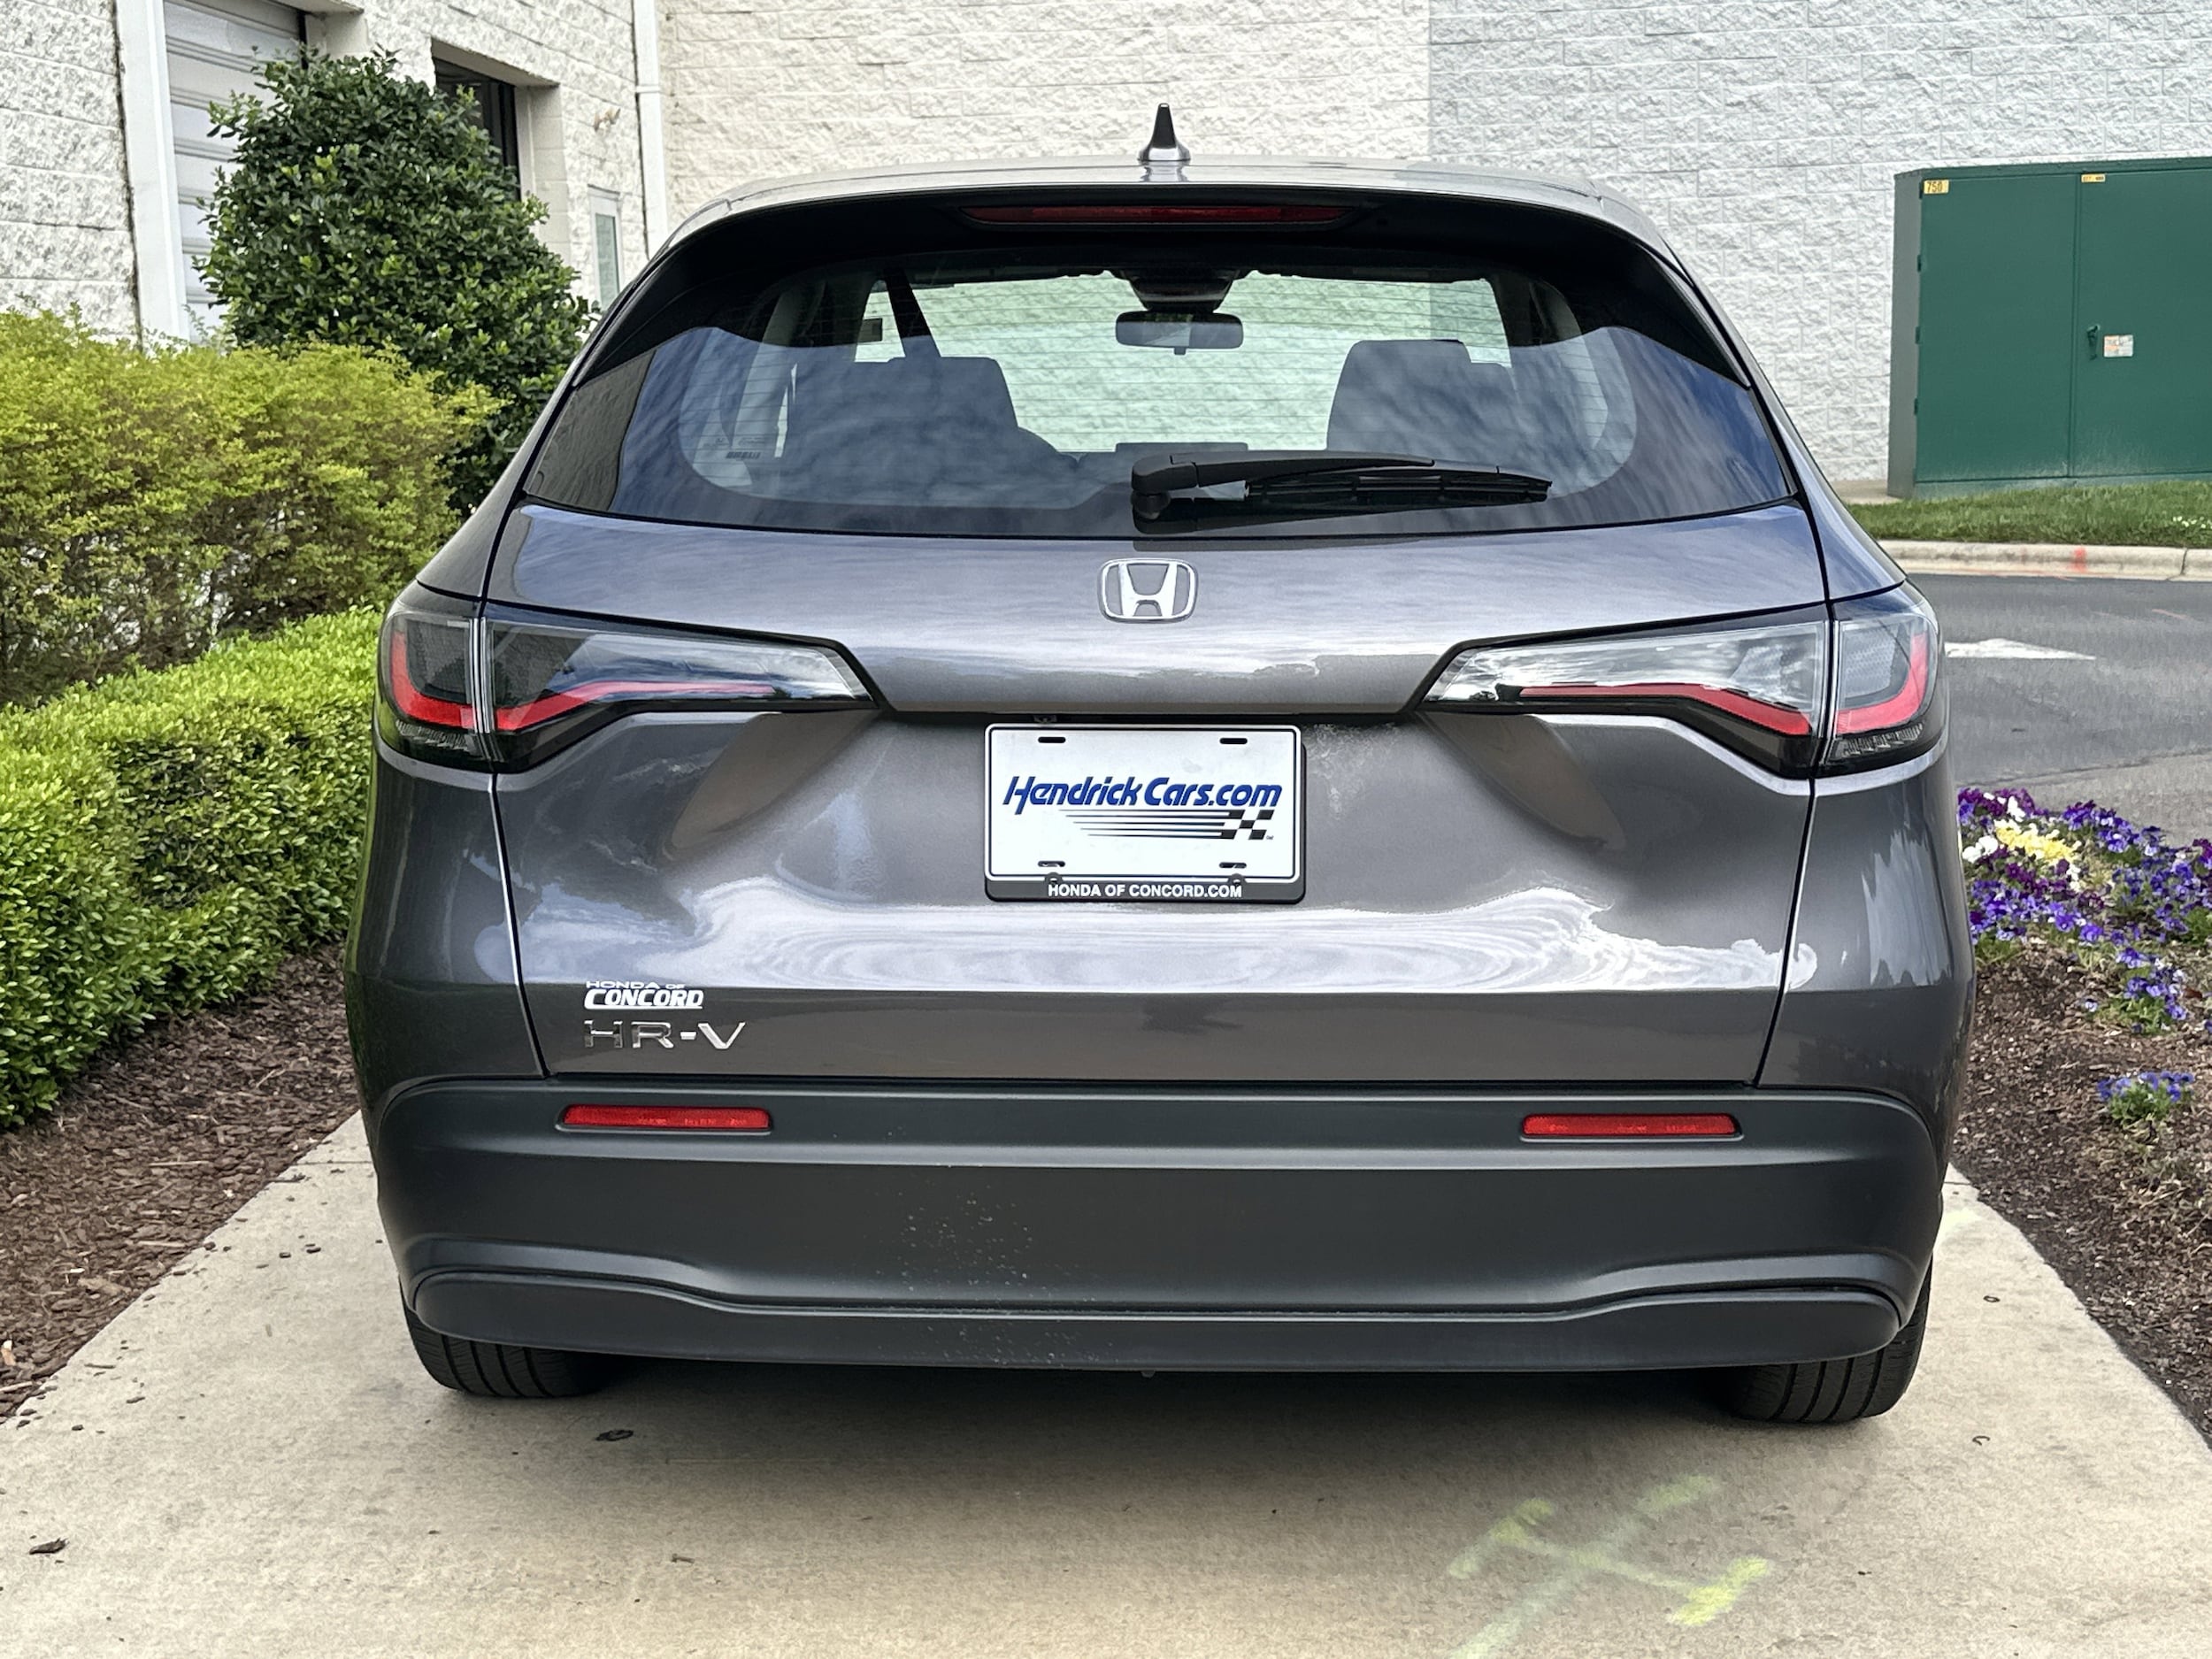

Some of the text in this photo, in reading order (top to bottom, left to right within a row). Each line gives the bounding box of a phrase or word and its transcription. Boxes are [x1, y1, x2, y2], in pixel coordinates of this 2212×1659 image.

[1048, 885, 1242, 898] HONDA OF CONCORD.COM
[585, 980, 660, 989] HONDA
[584, 988, 704, 1010] CONCORD
[584, 1019, 746, 1049] HR-V
